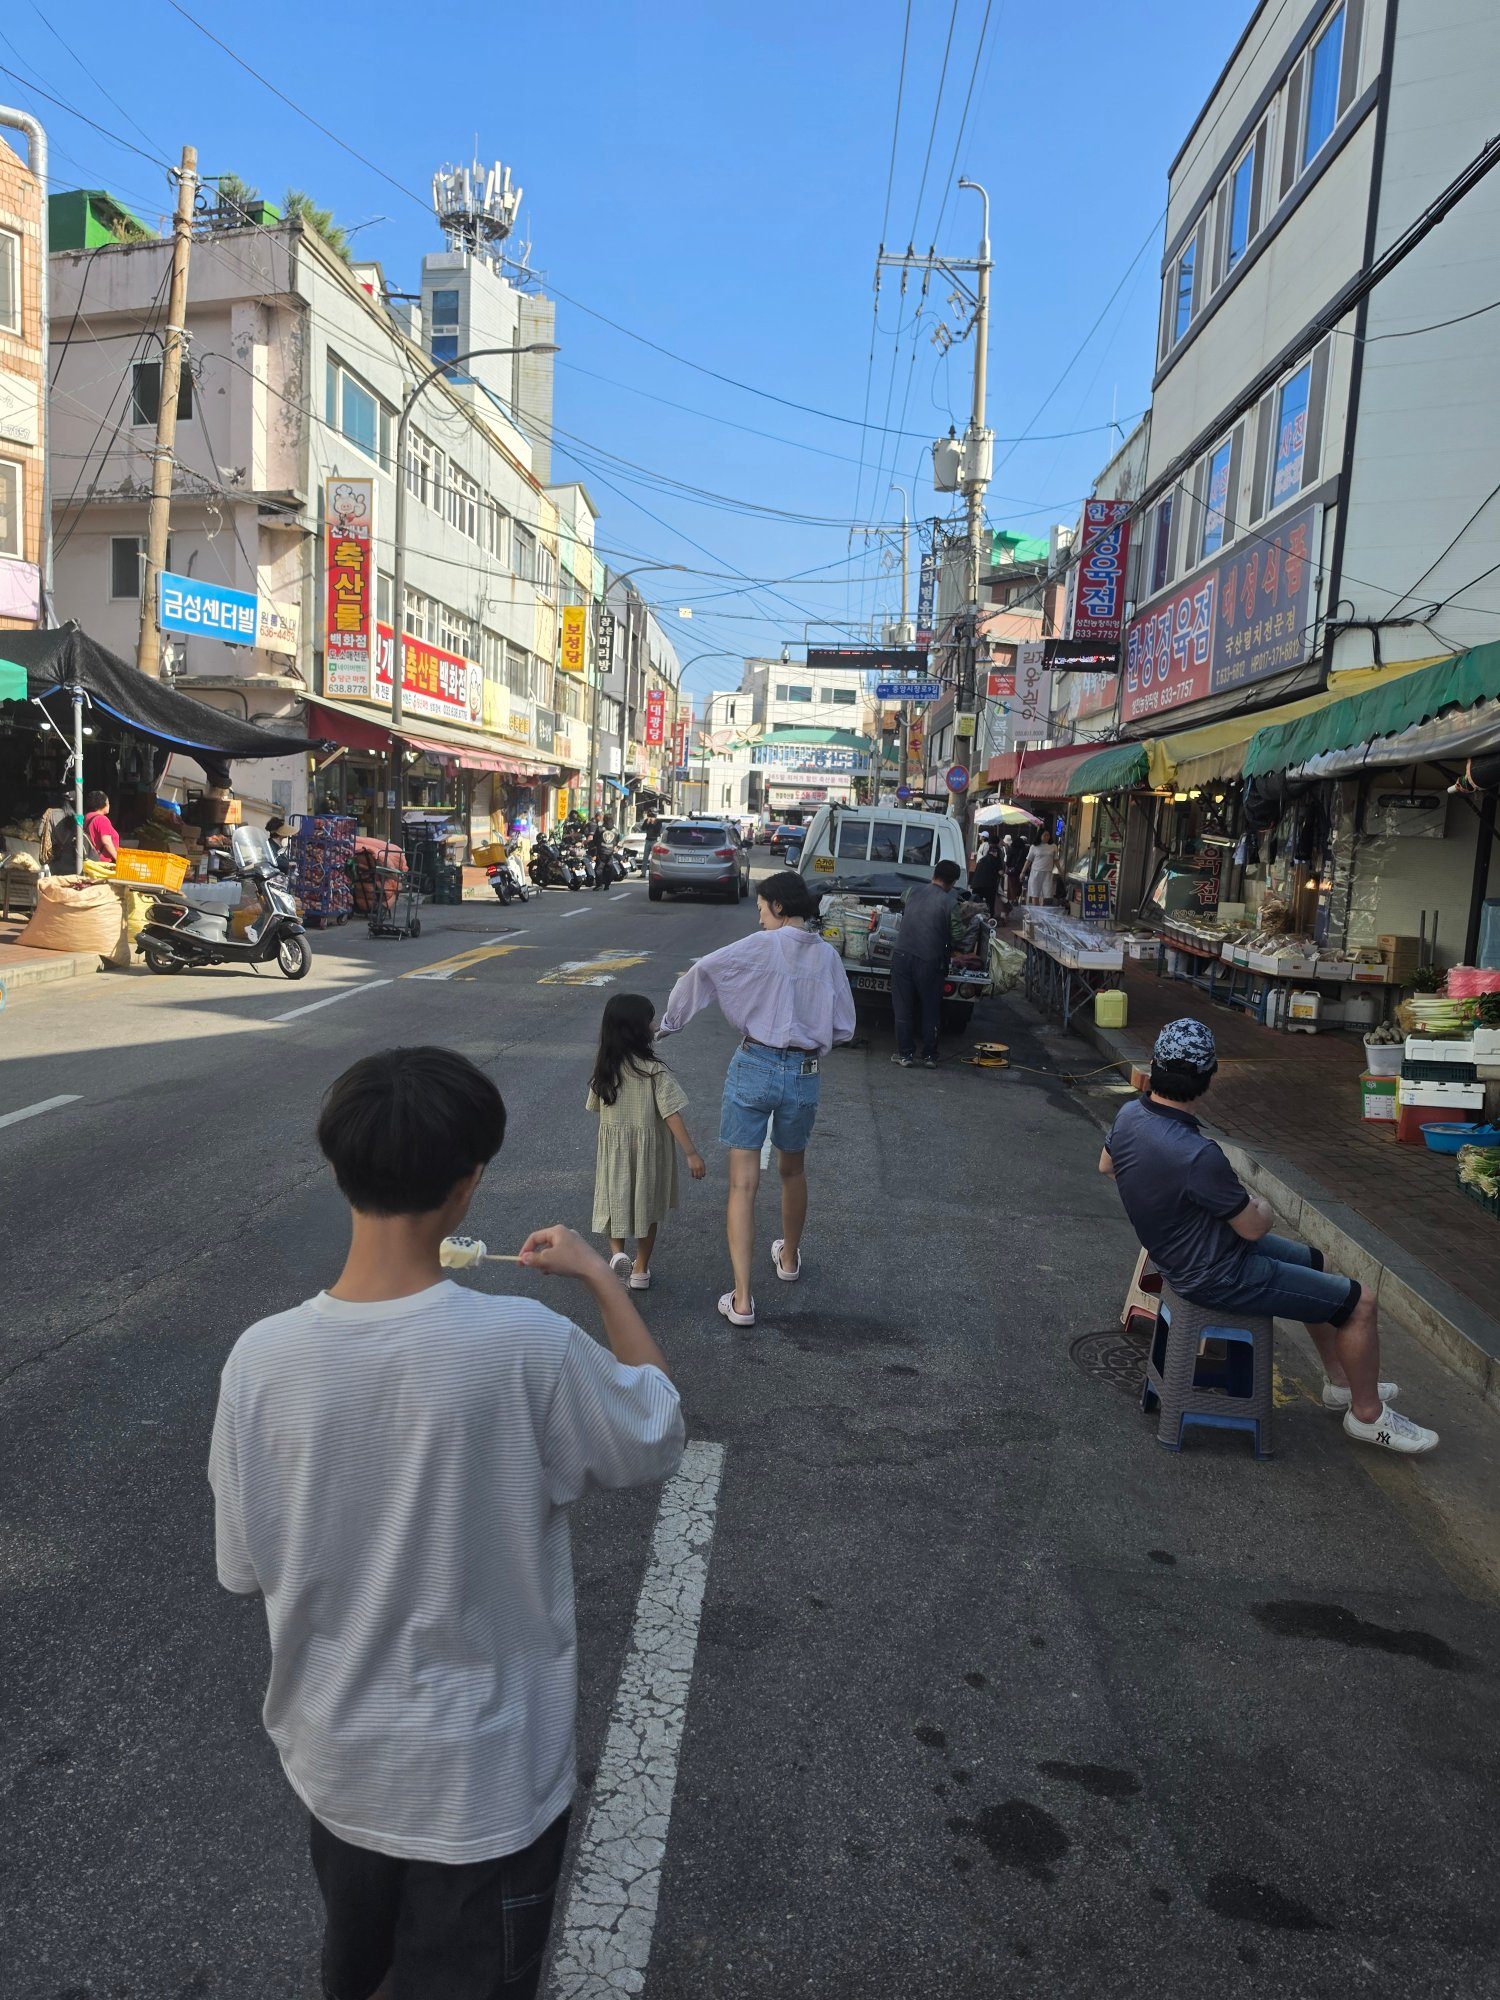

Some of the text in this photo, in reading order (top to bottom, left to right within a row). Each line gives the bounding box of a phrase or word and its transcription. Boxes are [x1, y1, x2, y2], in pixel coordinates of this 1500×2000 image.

[334, 541, 365, 631] 축산물
[1081, 525, 1122, 617] 정육점
[1221, 523, 1306, 628] 대성식품
[164, 589, 255, 634] 금성센터빌
[1225, 605, 1296, 659] 국산멸치전문점
[330, 633, 367, 648] 백화점
[565, 623, 582, 664] 보성당
[1075, 629, 1119, 639] 633-7757
[1127, 577, 1214, 693] 한성정육점
[328, 684, 368, 695] 638.8778
[439, 660, 467, 702] 백화점
[1160, 678, 1195, 707] 633-7757
[649, 704, 662, 741] 대광당
